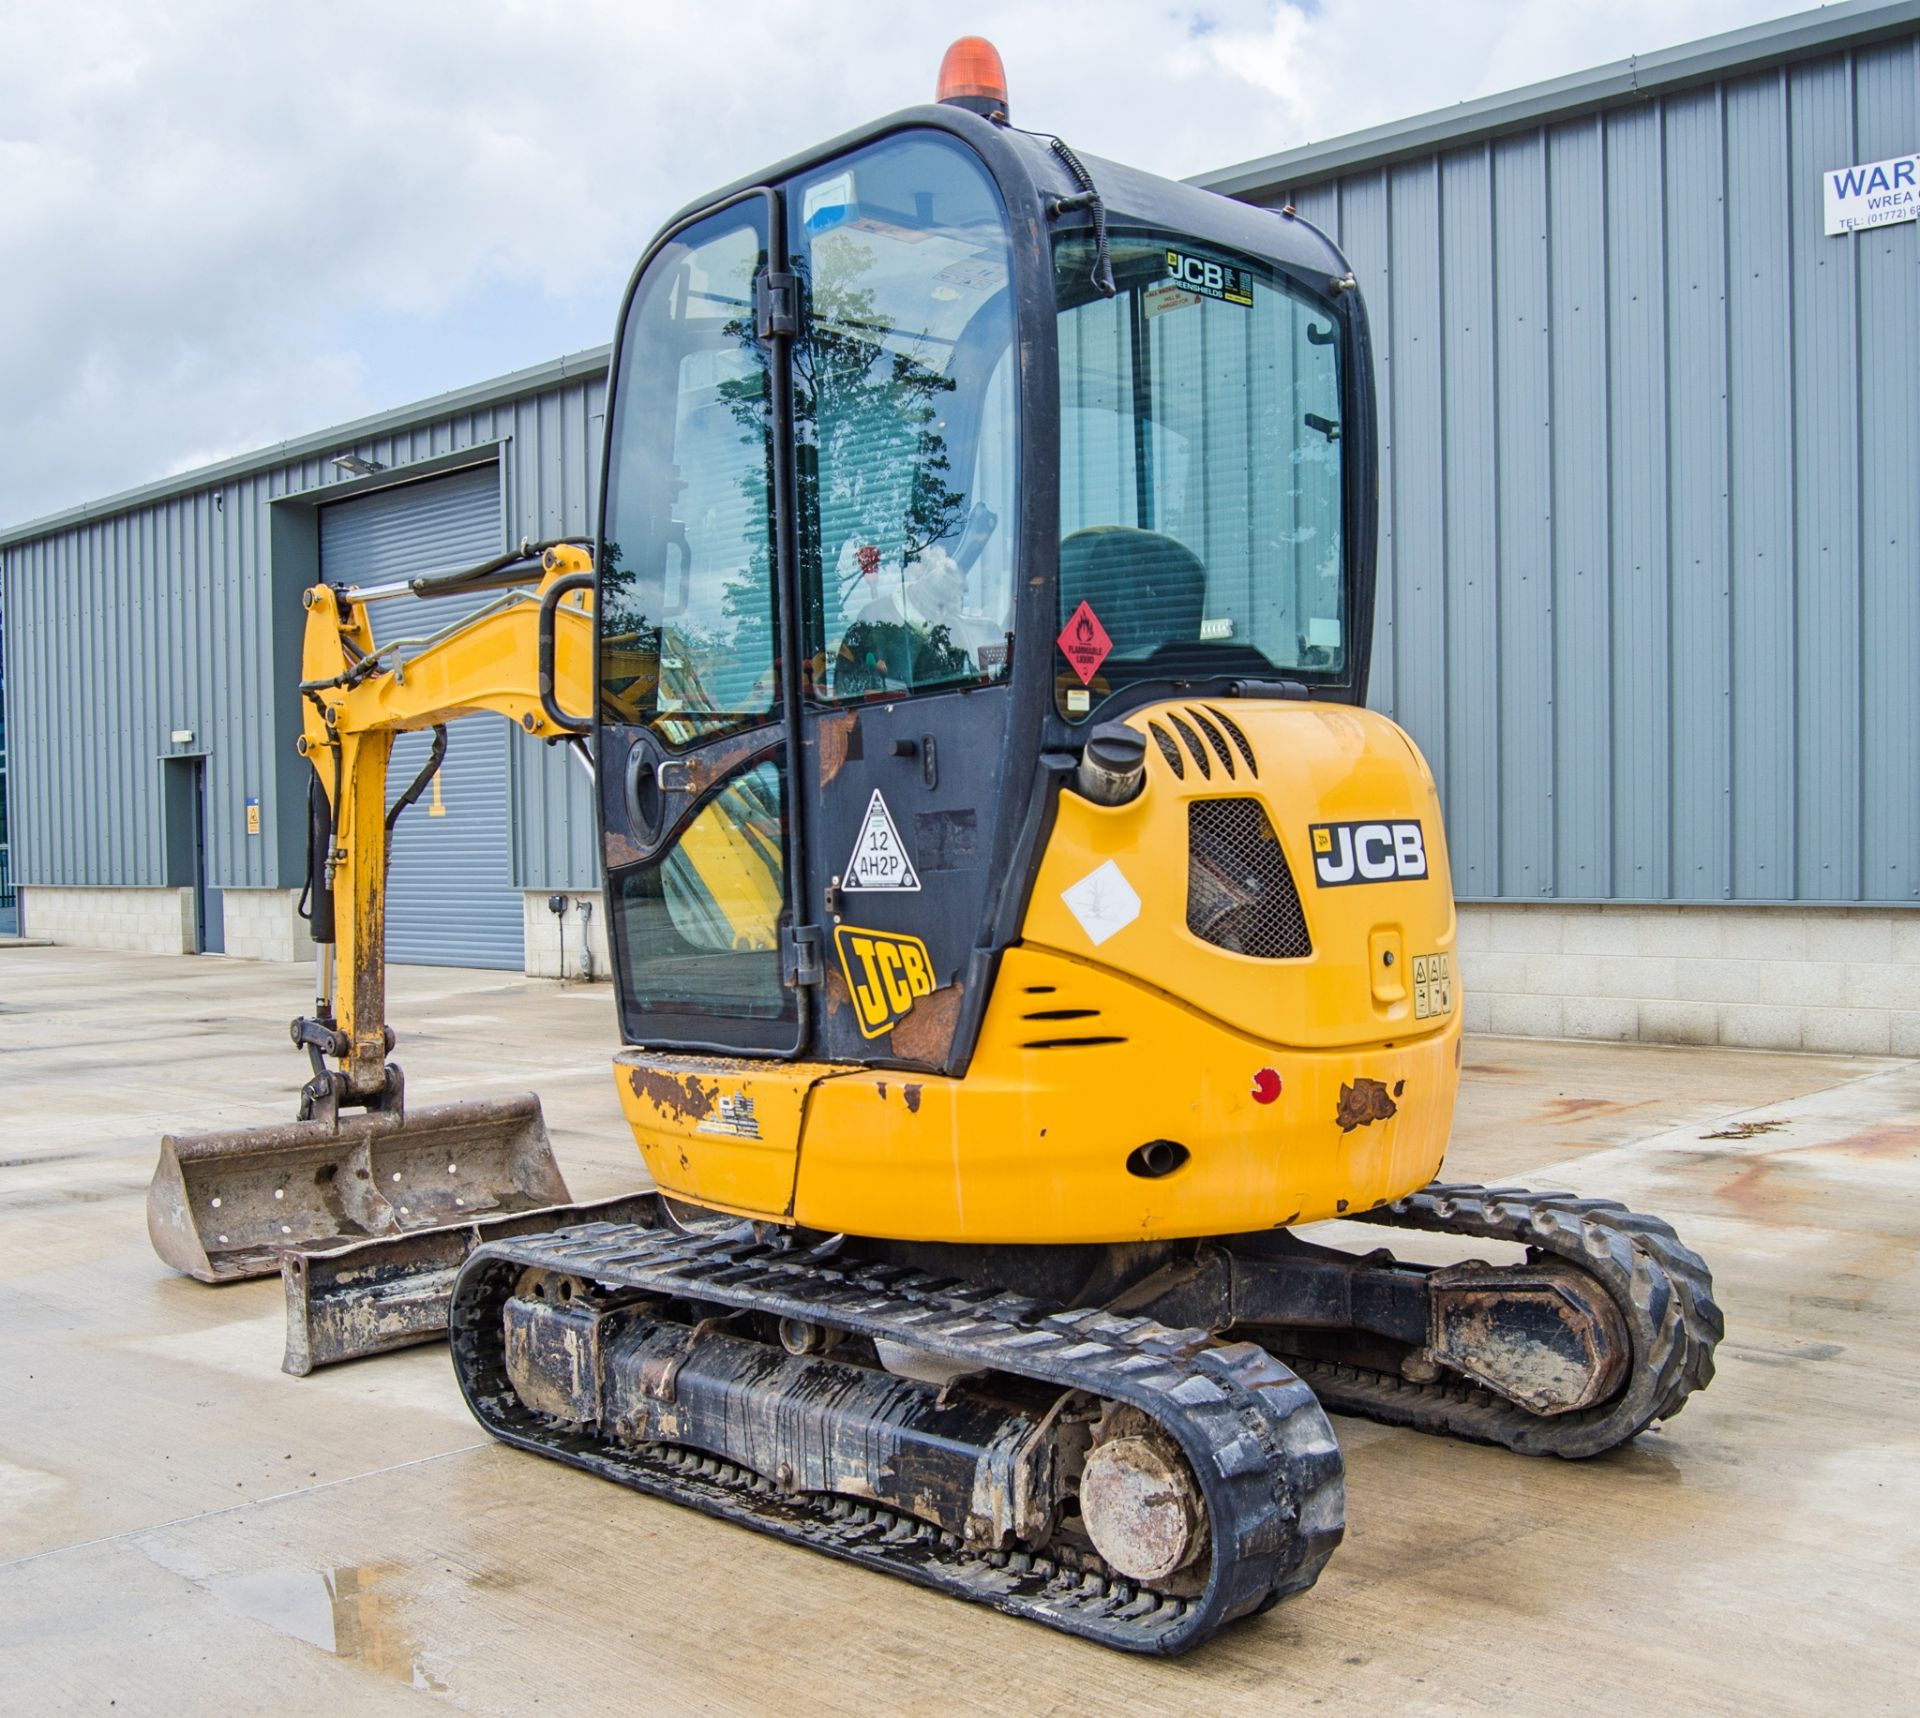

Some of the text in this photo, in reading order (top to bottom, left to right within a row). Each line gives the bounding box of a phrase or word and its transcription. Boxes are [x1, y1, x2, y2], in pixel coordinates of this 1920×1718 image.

[1833, 160, 1916, 200] WAR
[1868, 191, 1913, 210] WREA
[1840, 217, 1864, 229] TEL:
[1867, 208, 1906, 226] (01772)
[1168, 254, 1223, 289] JCB
[1174, 280, 1223, 299] REENSHIELDS
[1068, 644, 1102, 656] FLAMMABLE
[870, 831, 888, 851] 12
[1316, 824, 1426, 882] JCB
[860, 856, 899, 876] AH2P
[851, 937, 930, 1025] JCB
